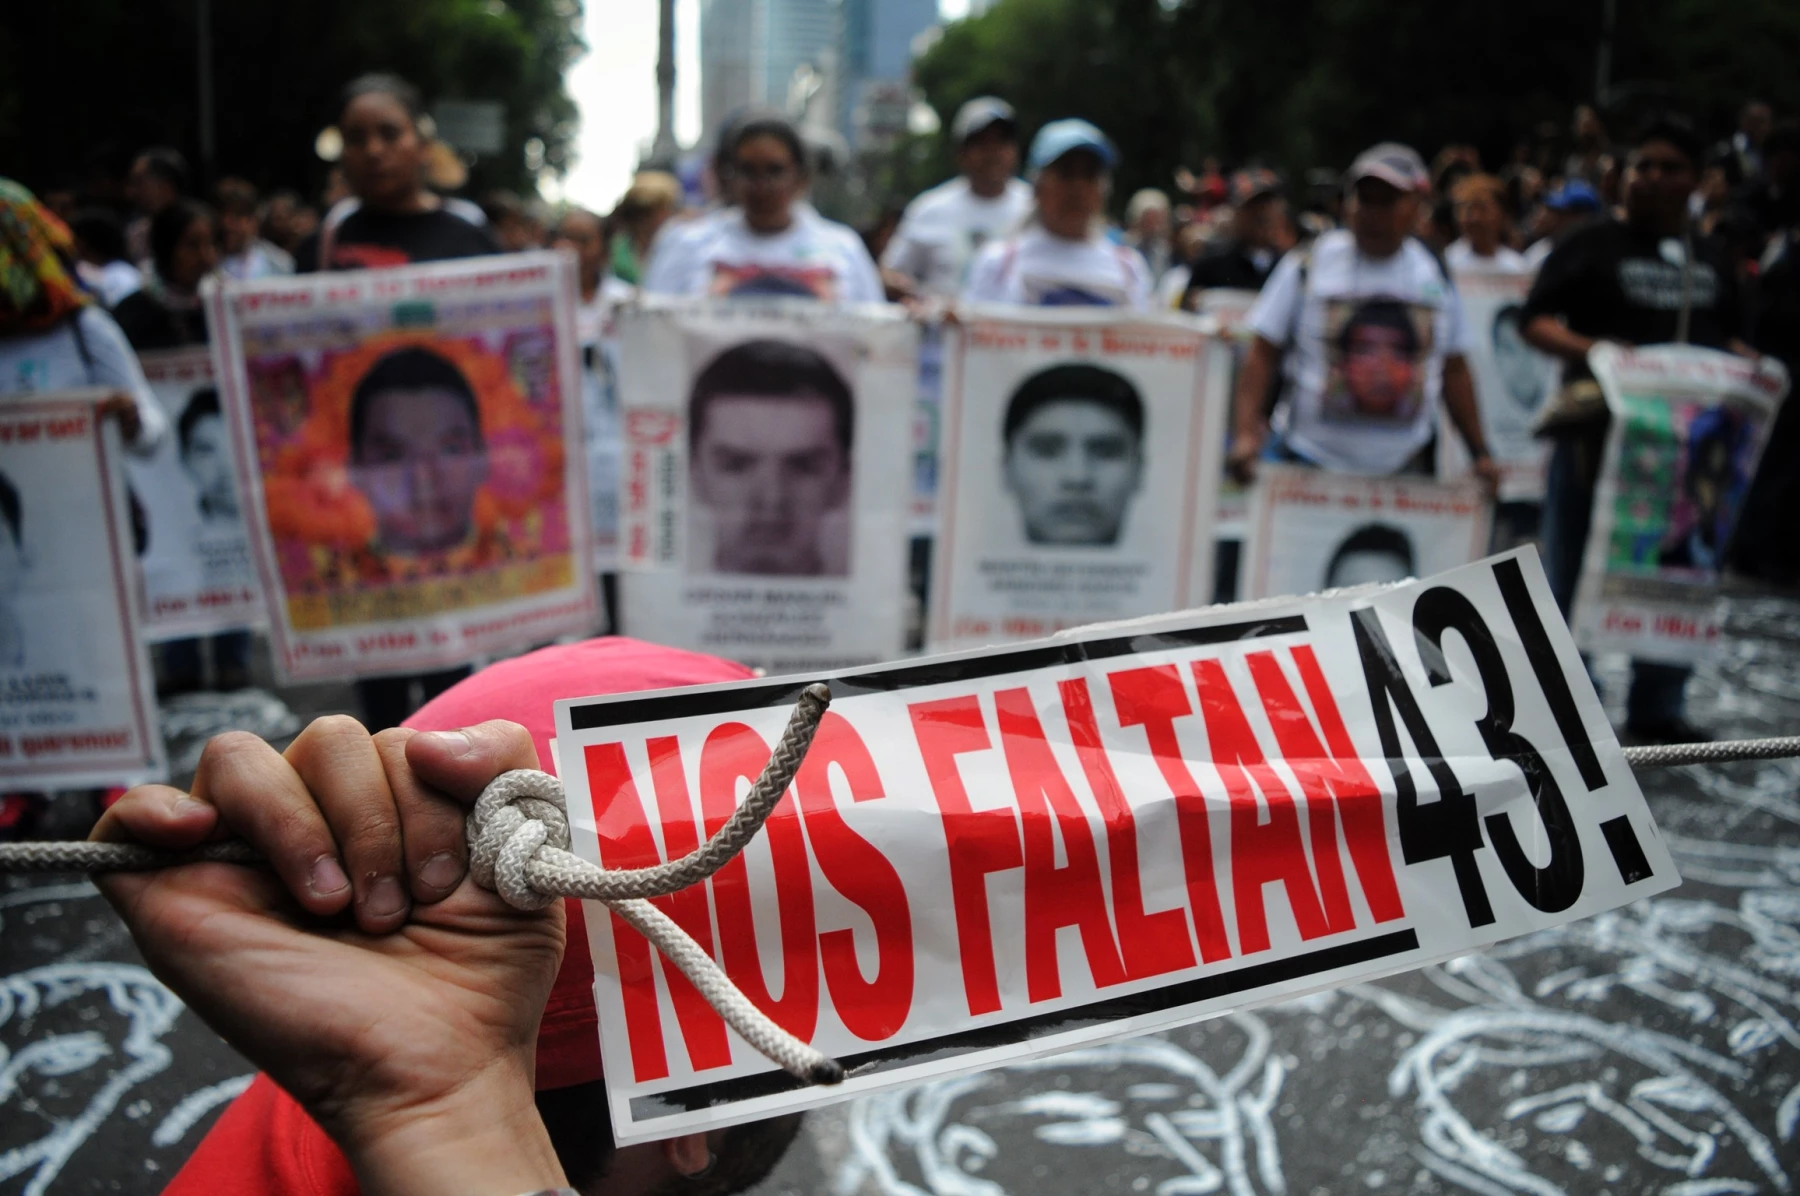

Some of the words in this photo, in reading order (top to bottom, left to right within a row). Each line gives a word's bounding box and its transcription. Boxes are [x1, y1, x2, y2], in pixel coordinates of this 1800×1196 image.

[585, 723, 914, 1082] NOS
[909, 643, 1406, 1017] FALTAN
[1350, 556, 1653, 928] 43!
